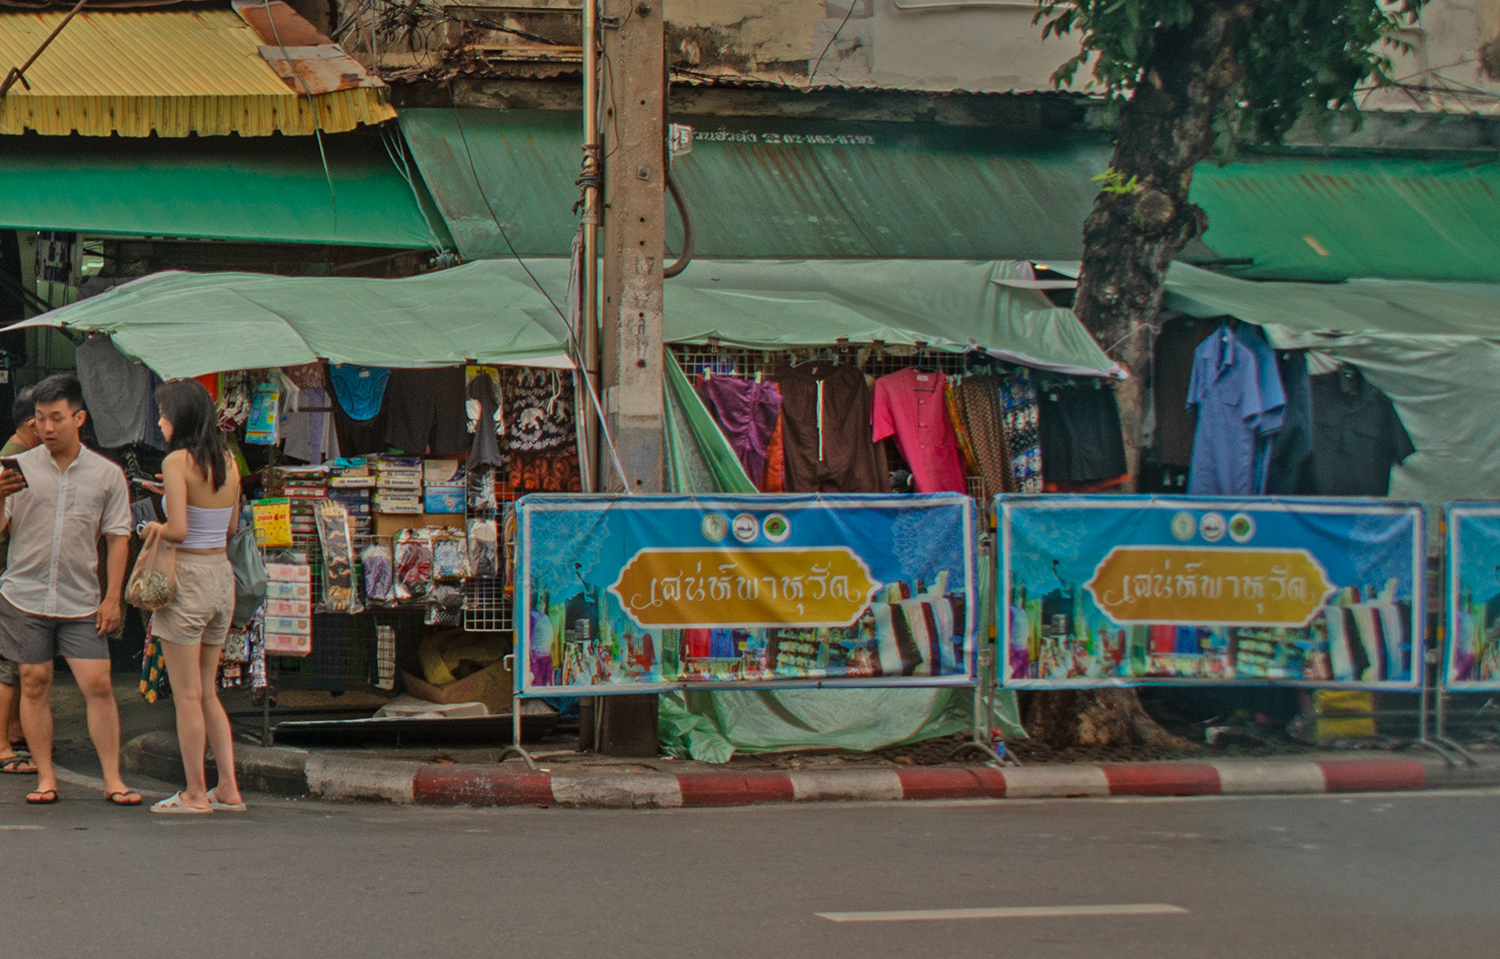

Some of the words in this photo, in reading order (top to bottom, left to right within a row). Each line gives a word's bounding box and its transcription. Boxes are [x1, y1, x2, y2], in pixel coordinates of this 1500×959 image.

[630, 559, 861, 617] เสน่ห์พาหุรัด
[1102, 558, 1315, 615] เสน่ห์พาหุรัด
